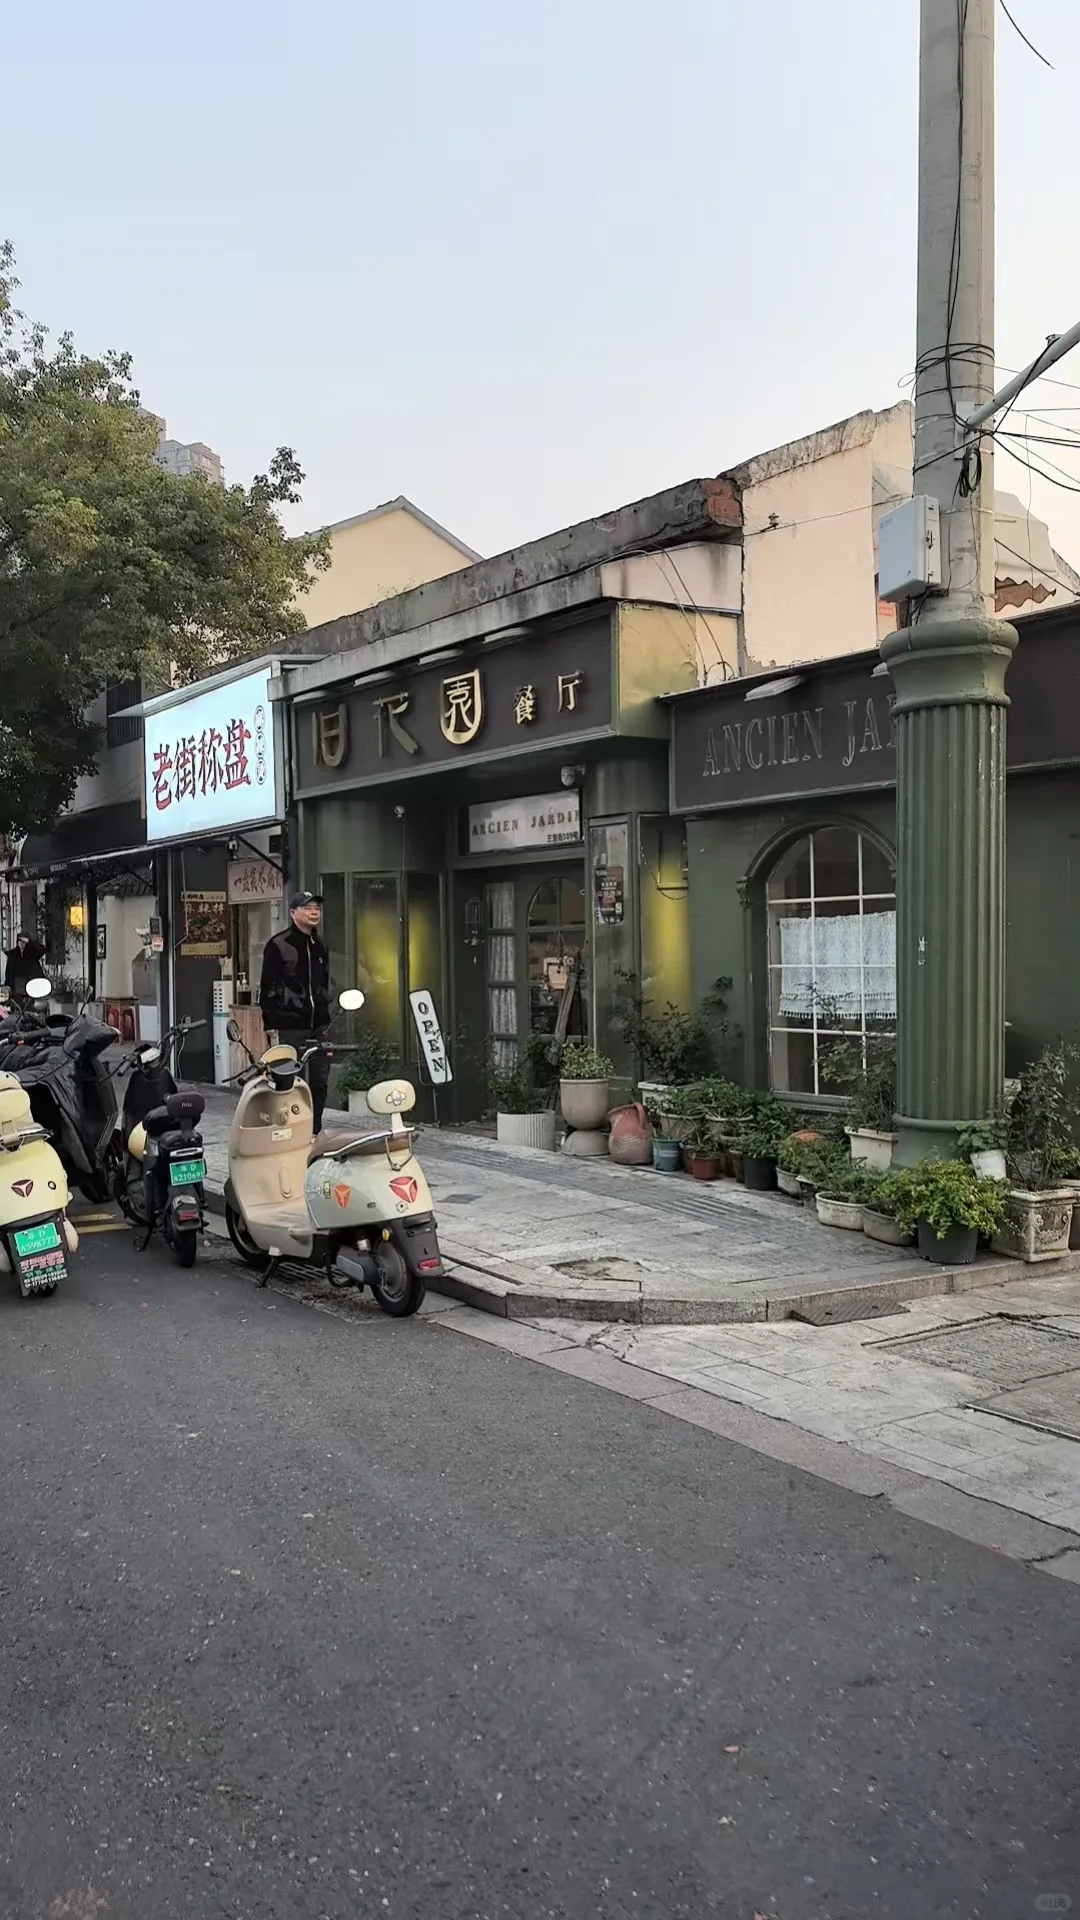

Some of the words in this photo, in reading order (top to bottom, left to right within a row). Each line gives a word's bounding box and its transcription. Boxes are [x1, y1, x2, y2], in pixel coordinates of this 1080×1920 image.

[702, 707, 823, 776] ANCIEN
[471, 818, 519, 837] ANCIEN
[418, 1001, 446, 1072] OPEN
